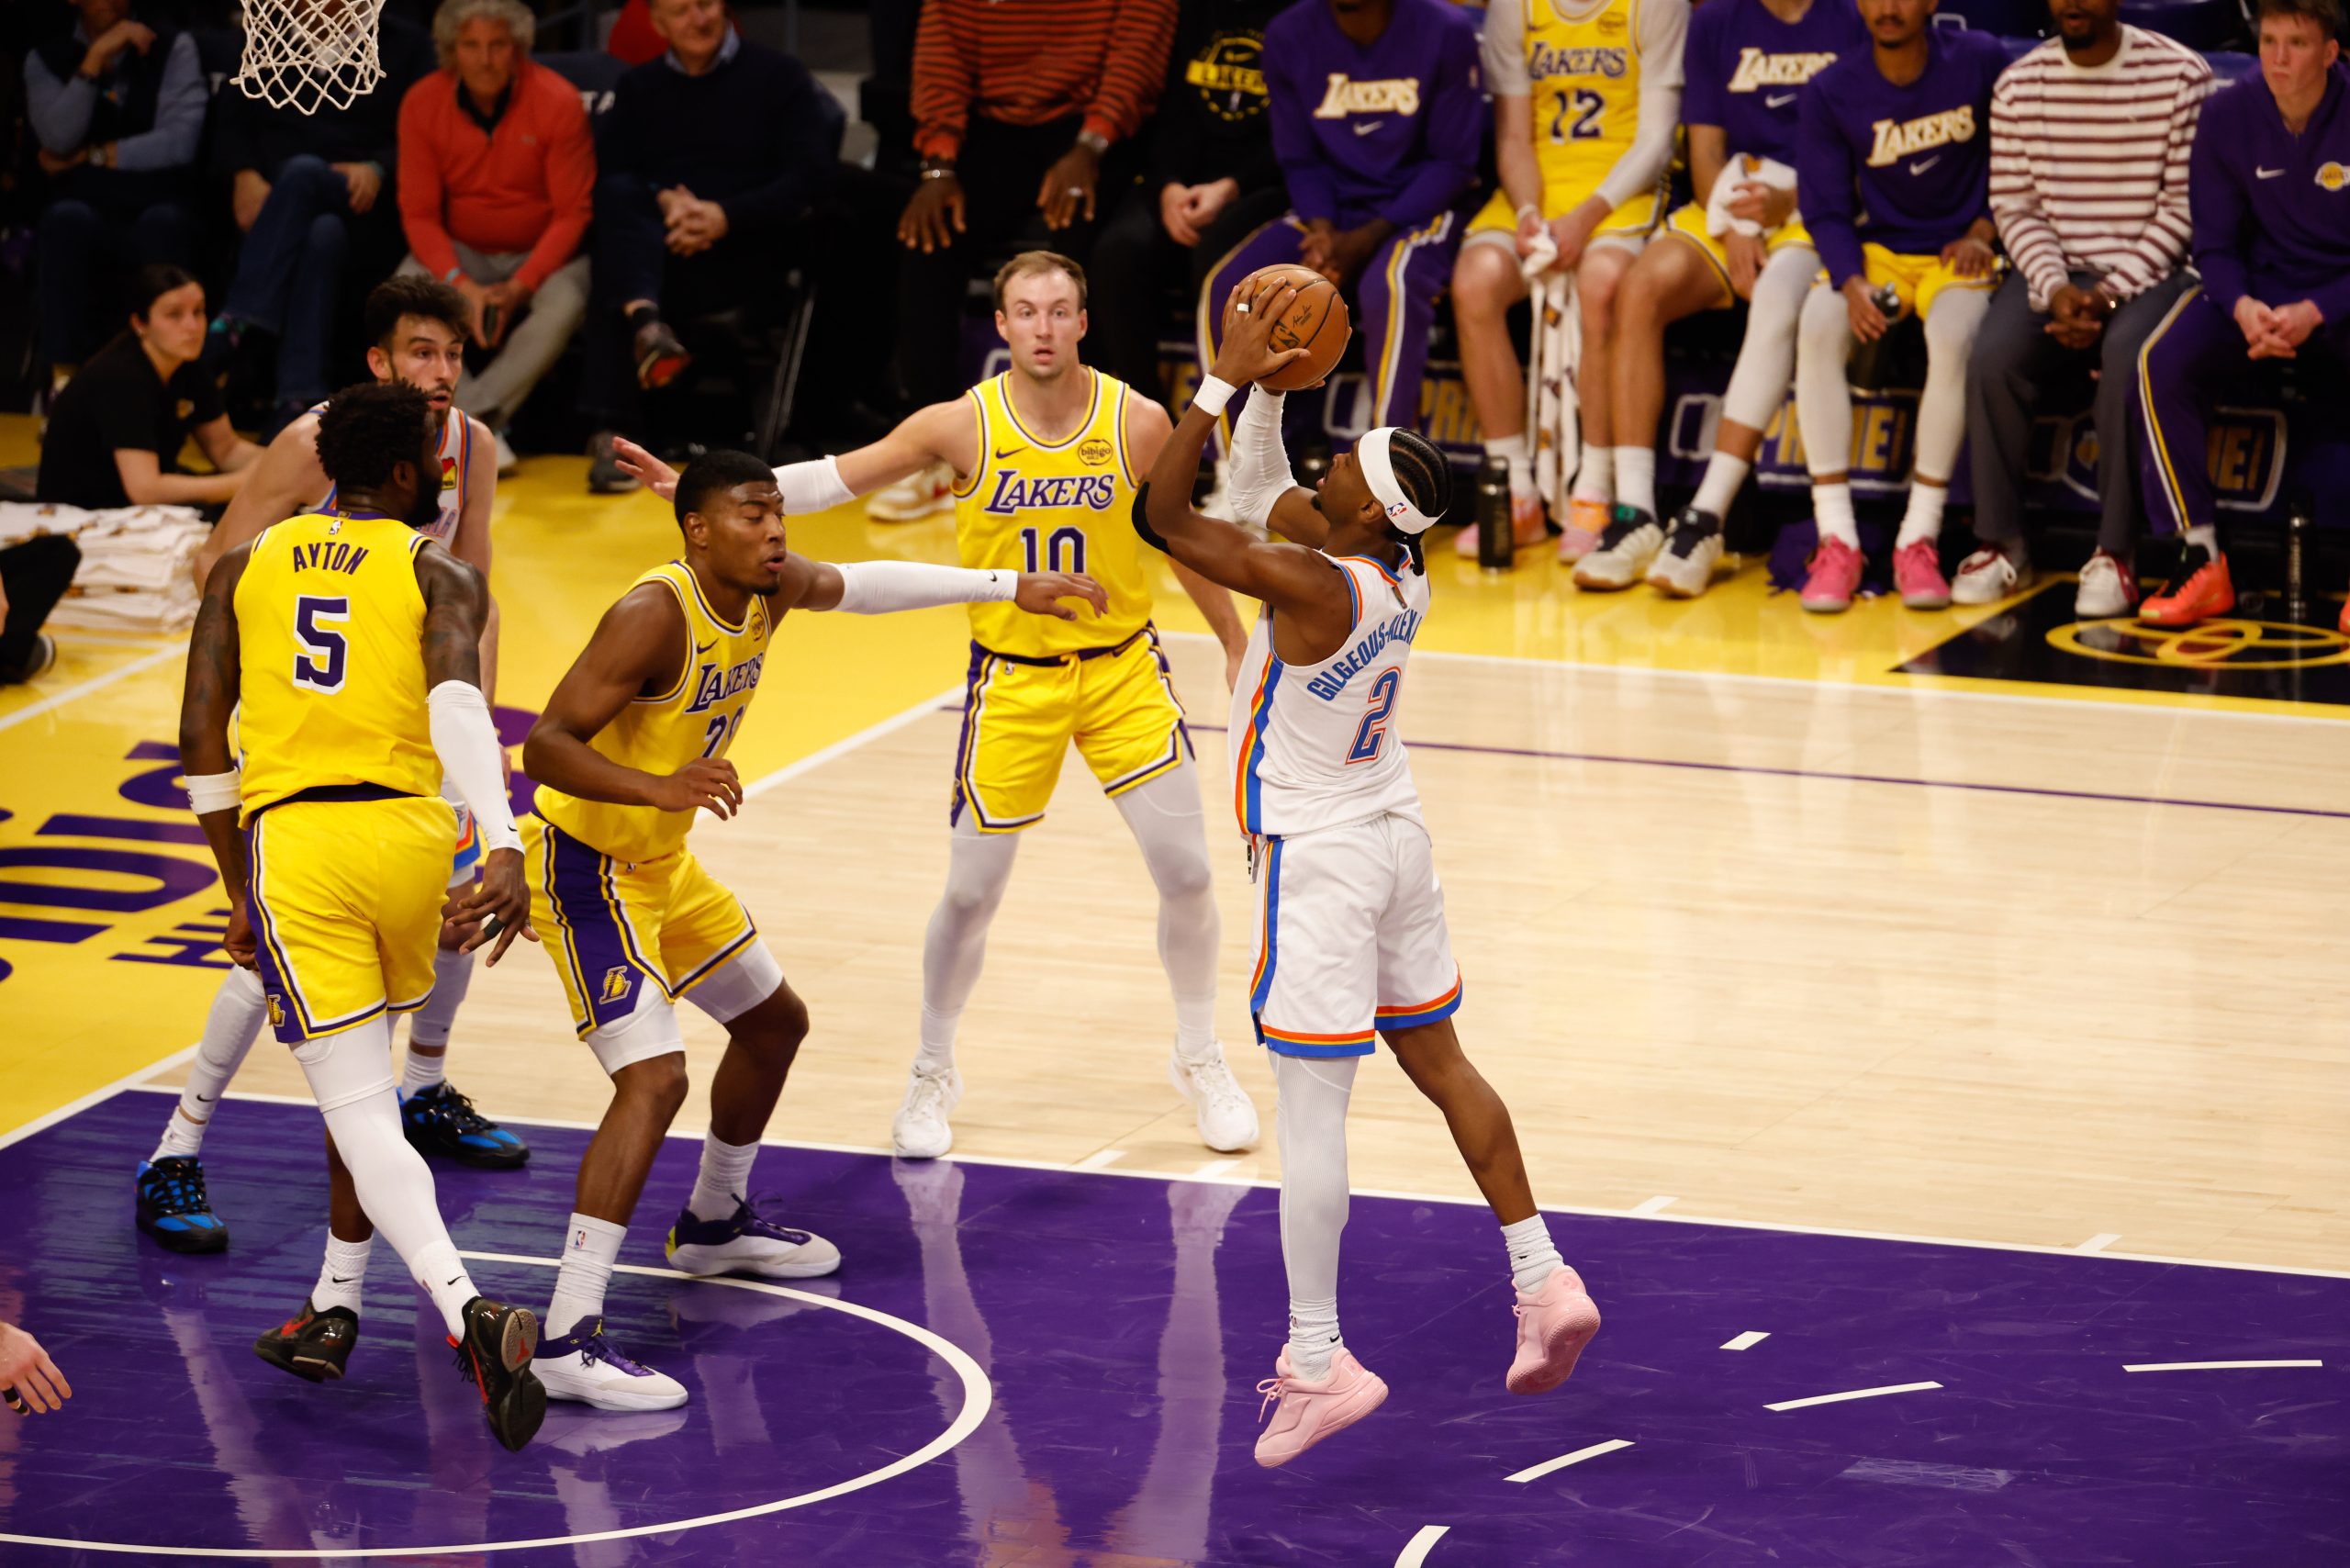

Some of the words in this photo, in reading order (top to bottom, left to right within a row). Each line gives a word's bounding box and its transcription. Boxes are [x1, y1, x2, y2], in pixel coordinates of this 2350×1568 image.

[1528, 41, 1628, 81] LAKERS
[1313, 73, 1420, 118] LAKERS
[1550, 87, 1606, 143] 12
[1865, 104, 1975, 167] LAKERS
[983, 468, 1116, 516] LAKERS
[293, 542, 370, 576] AYTON
[1020, 525, 1088, 575] 10
[291, 593, 352, 697] 5
[682, 651, 766, 715] LAKERS
[1345, 665, 1403, 765] 2
